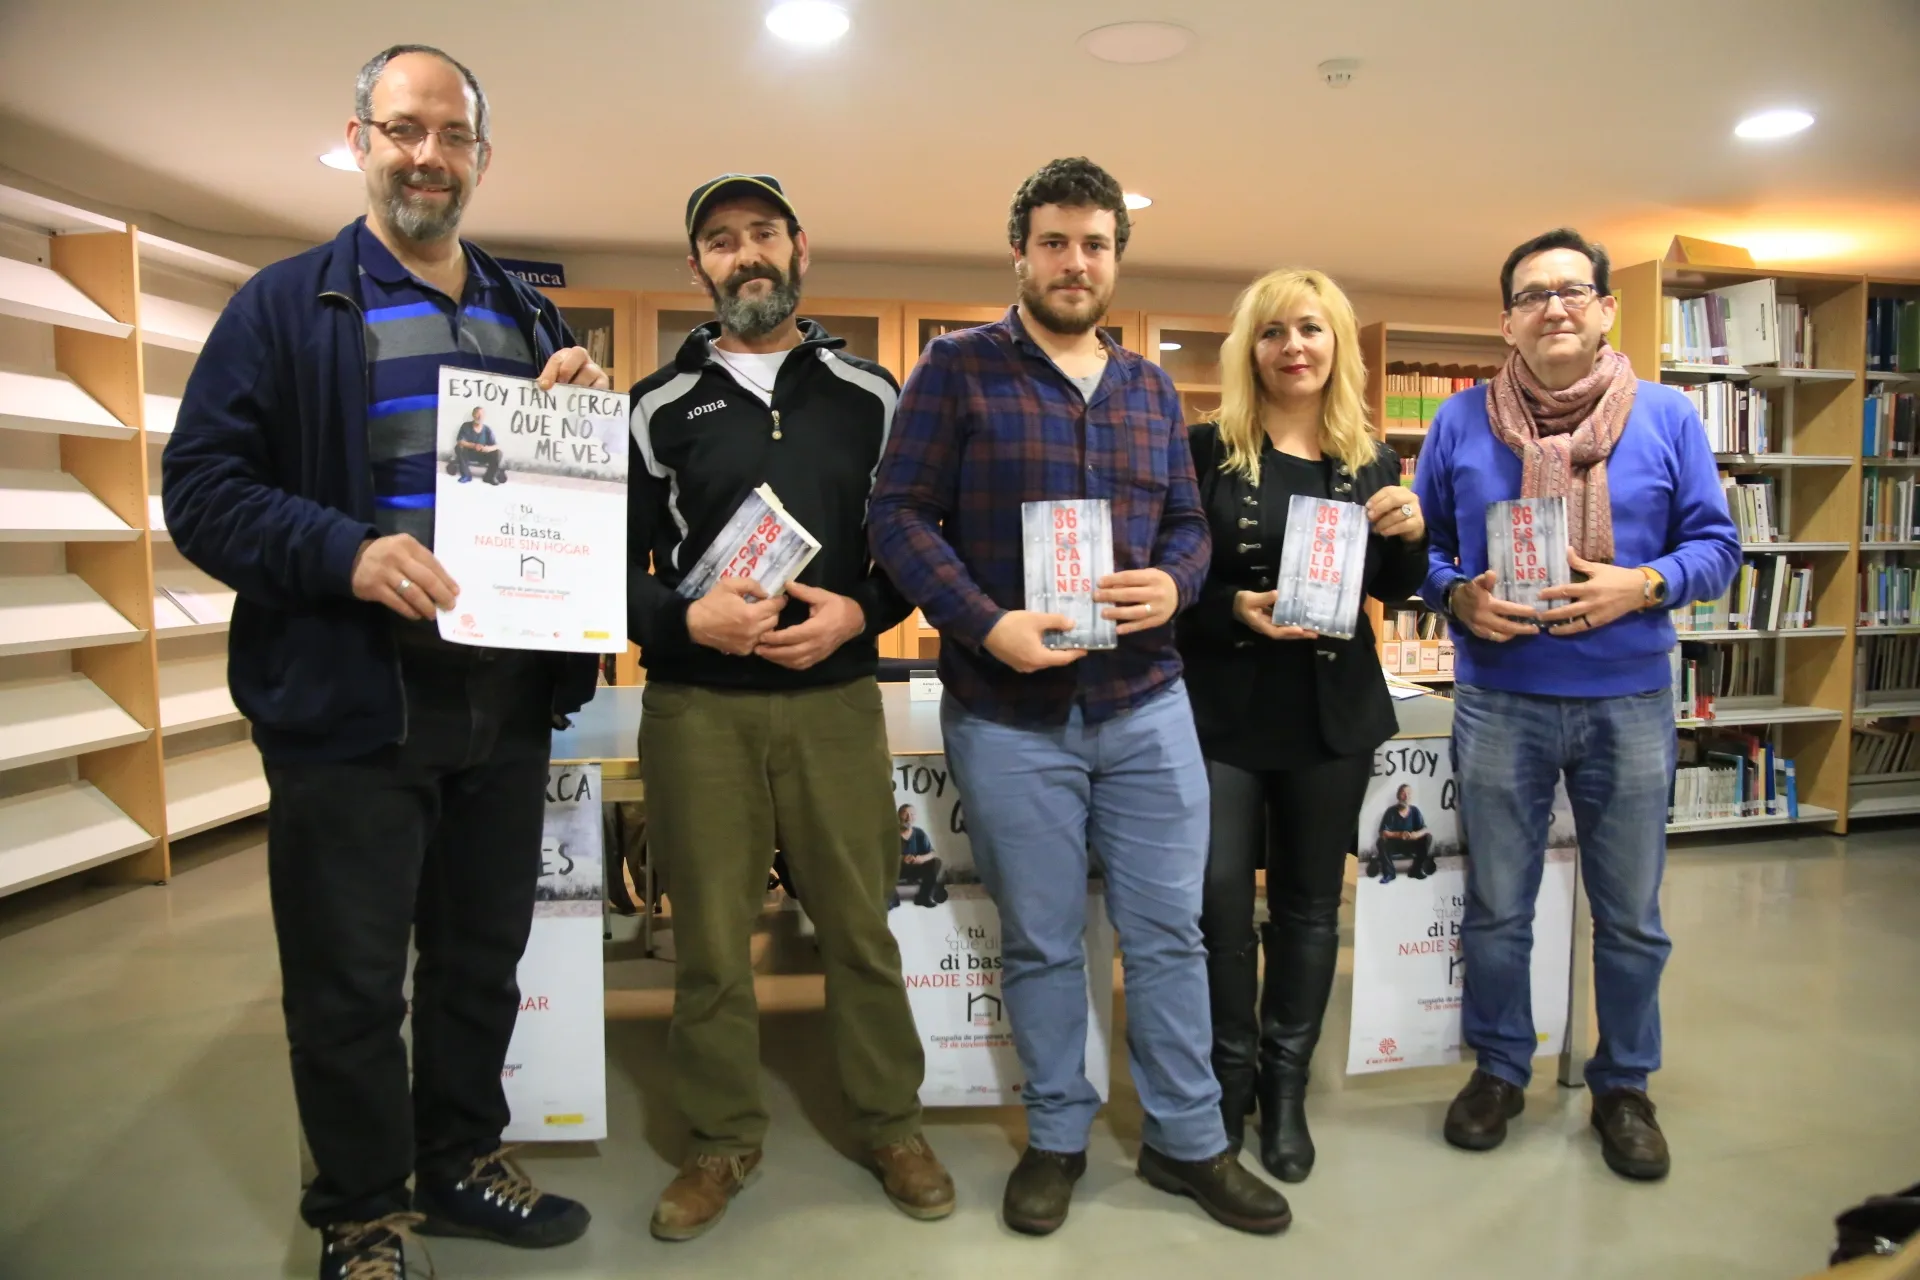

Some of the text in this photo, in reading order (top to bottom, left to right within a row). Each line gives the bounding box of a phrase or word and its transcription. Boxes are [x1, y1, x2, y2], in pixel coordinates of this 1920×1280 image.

[449, 378, 623, 418] ESTOY TAN CERCA
[510, 410, 593, 439] QUE NO
[535, 439, 611, 464] ME VES
[1054, 508, 1077, 529] 36
[1316, 505, 1339, 526] 36
[1511, 506, 1533, 526] 36
[500, 522, 565, 541] di basta.
[757, 515, 782, 544] 36
[474, 535, 590, 556] NADIE SIN HOGAR
[1371, 747, 1439, 778] ESTOY
[968, 925, 985, 938] tú
[1427, 920, 1444, 937] di
[1398, 939, 1444, 955] NADIE
[940, 953, 960, 970] di
[906, 971, 994, 988] NADIE SIN
